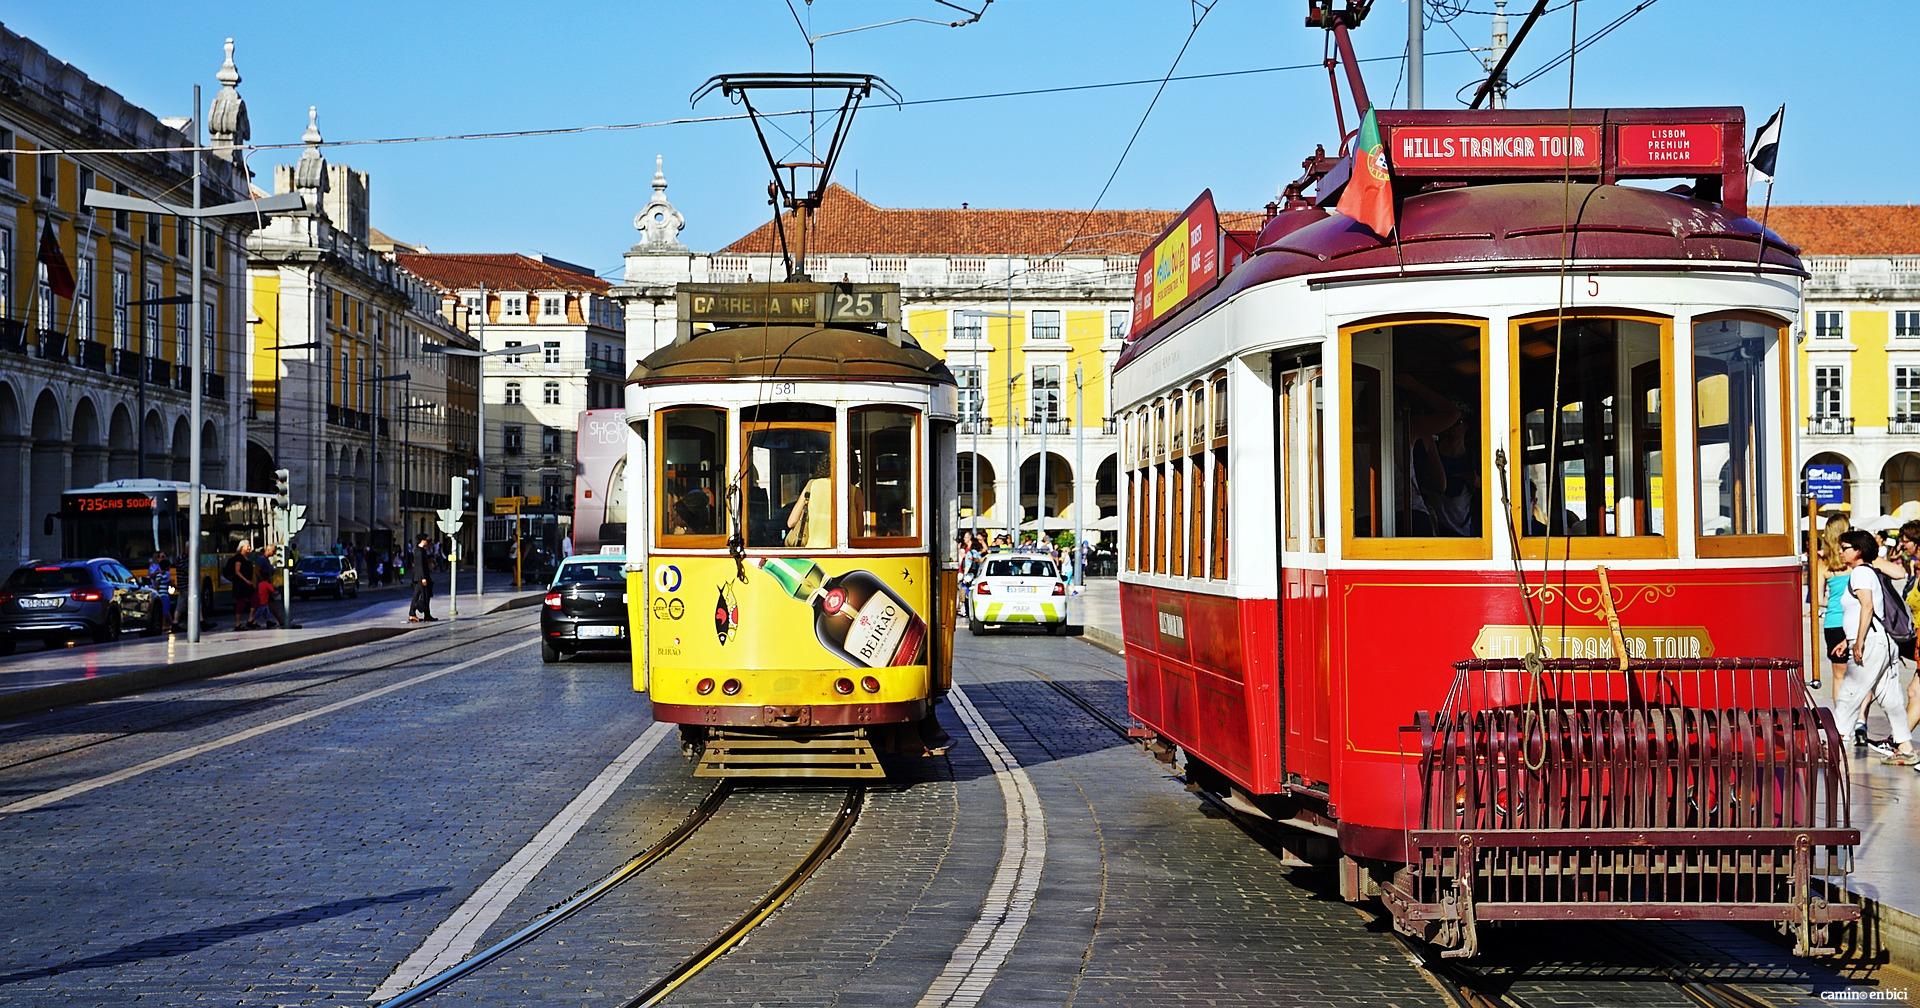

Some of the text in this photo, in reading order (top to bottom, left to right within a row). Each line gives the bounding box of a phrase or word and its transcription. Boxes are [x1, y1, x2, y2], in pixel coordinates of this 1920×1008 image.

[1651, 129, 1686, 139] LISBON
[1403, 136, 1585, 158] HILLS TRAMCAR TOUR
[1648, 140, 1690, 149] PREMIUM
[1648, 151, 1690, 160] TRAMCAR
[1587, 273, 1599, 297] 5
[837, 294, 873, 317] 25
[775, 383, 797, 396] 581
[78, 498, 103, 512] 735
[860, 605, 896, 659] BEIRÃO
[1557, 636, 1647, 659] TRAMAR
[1652, 636, 1700, 659] TOUR
